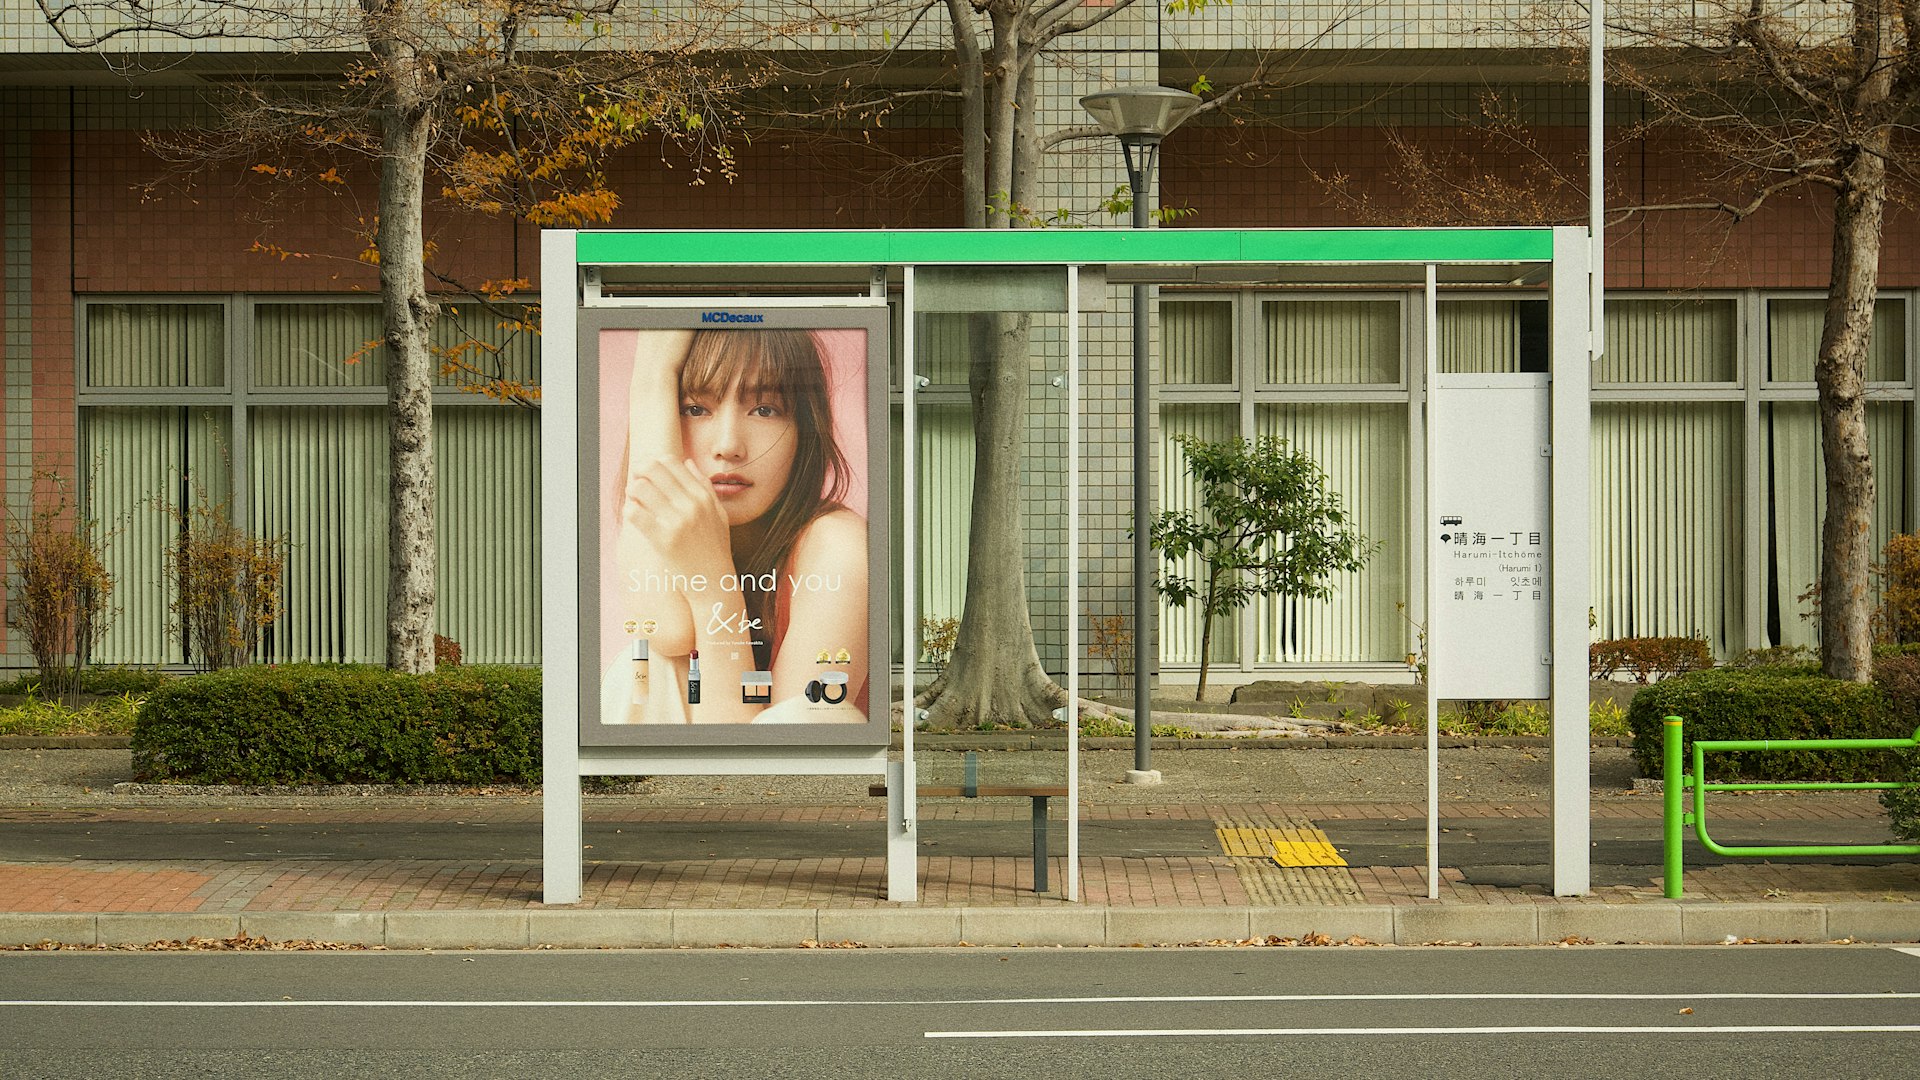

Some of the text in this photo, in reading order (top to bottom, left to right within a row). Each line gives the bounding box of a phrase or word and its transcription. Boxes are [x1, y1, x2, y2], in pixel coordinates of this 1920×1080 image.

[702, 312, 763, 323] MCDecaux
[1454, 532, 1541, 546] 晴海一丁目
[1498, 564, 1543, 573] (Harumi 1)
[628, 569, 841, 597] Shine and you
[1455, 576, 1542, 587] 하루미 잇초메
[1454, 590, 1541, 601] 晴海一丁目
[706, 601, 763, 636] &be
